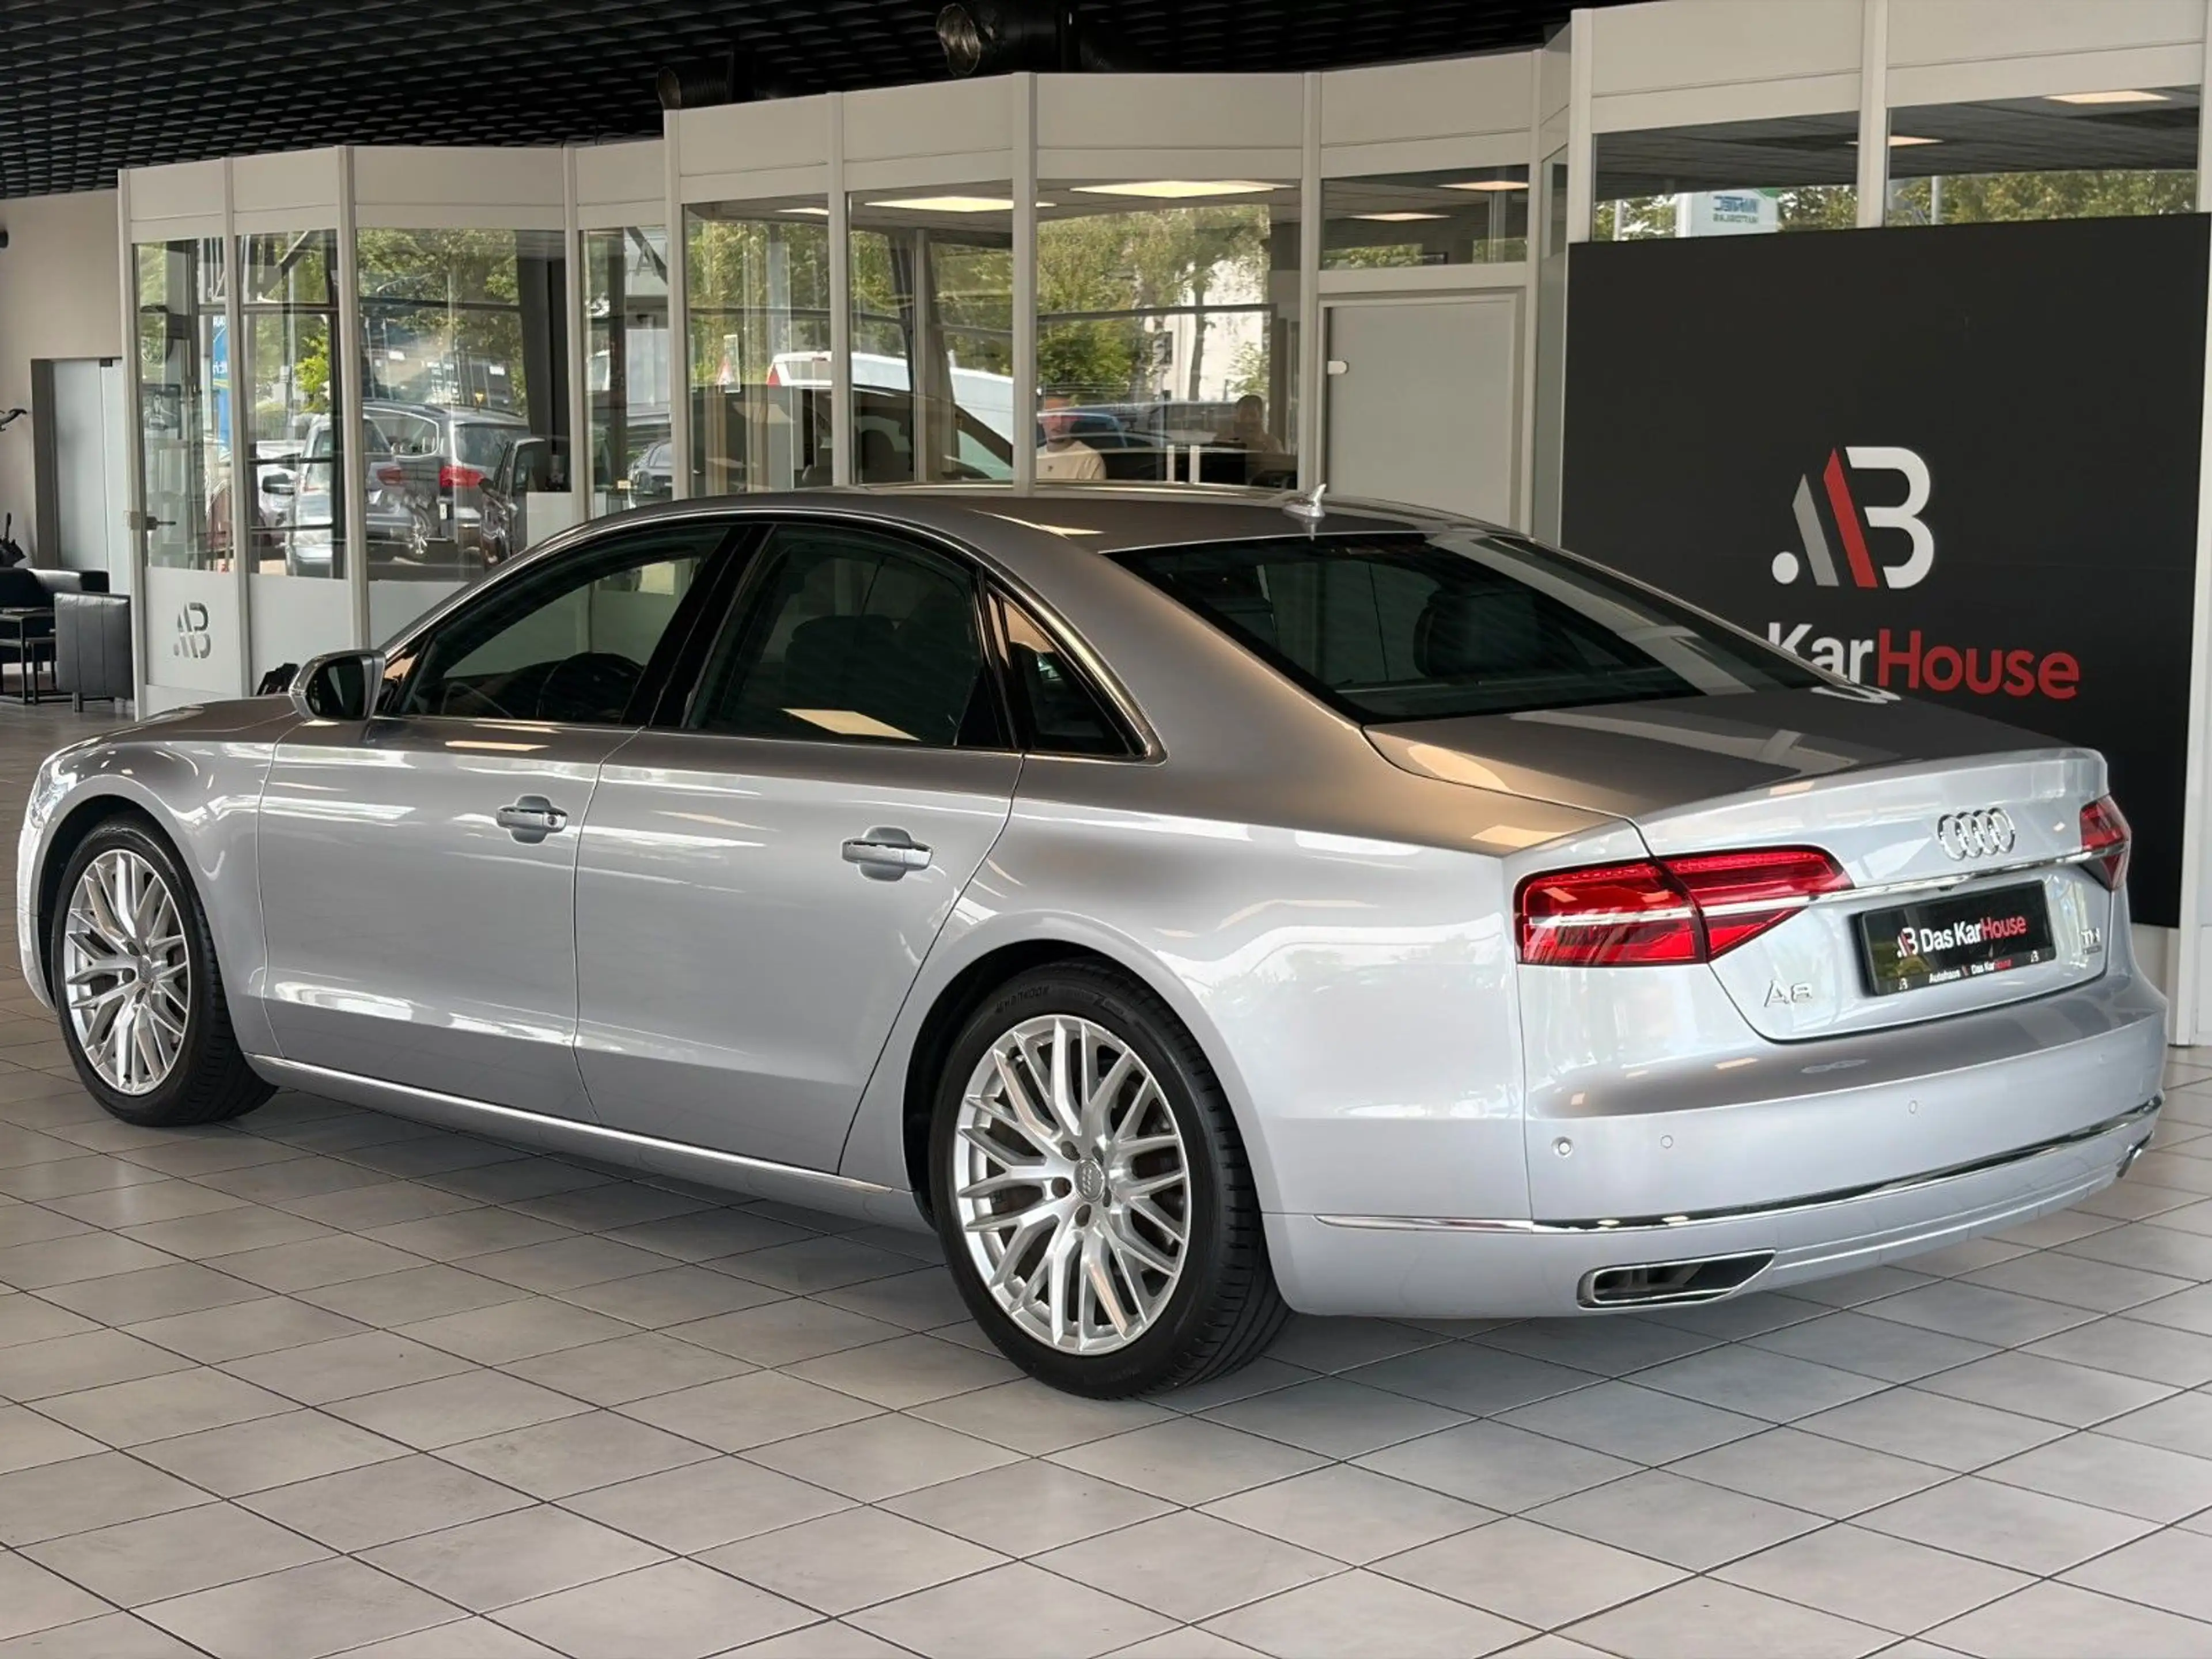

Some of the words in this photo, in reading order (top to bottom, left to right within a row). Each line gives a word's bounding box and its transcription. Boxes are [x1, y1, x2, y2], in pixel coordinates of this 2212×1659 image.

[1767, 622, 2080, 700] KarHouse
[1919, 928, 1955, 953] Das
[1954, 916, 2026, 946] KarHouse
